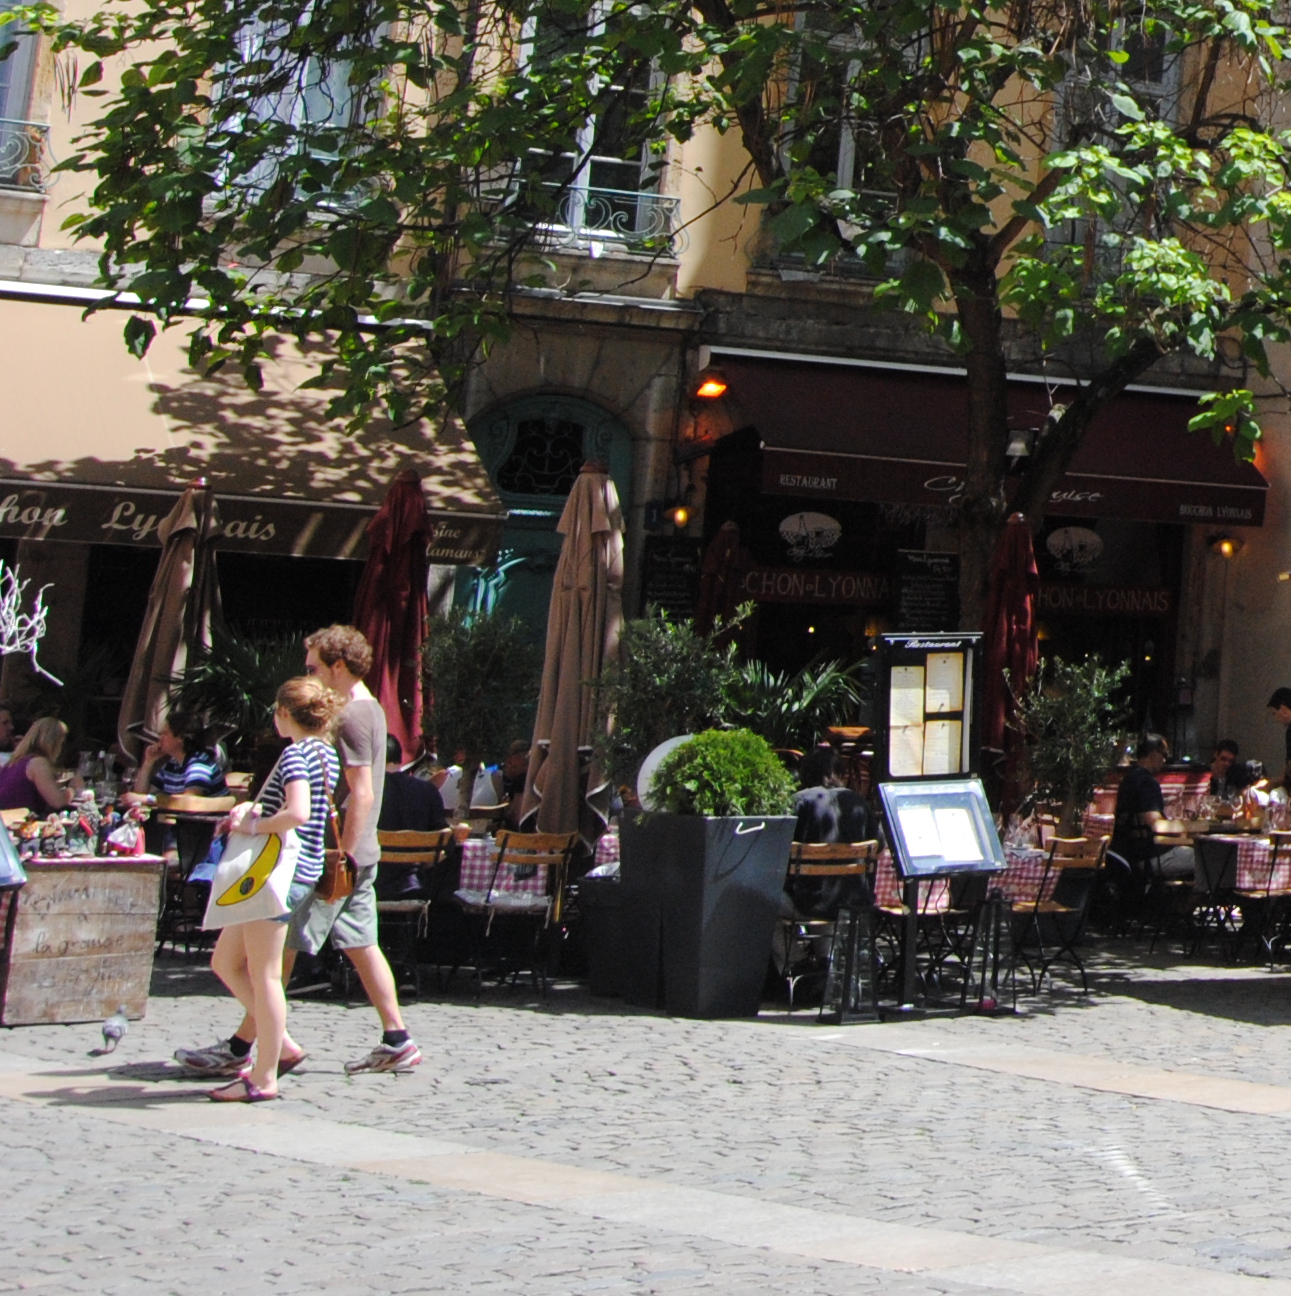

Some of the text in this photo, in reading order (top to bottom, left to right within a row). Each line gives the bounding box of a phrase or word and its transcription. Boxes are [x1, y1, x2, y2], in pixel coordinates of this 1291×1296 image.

[779, 473, 838, 490] RESTAURANT
[101, 501, 276, 542] Lyais
[1179, 504, 1253, 519] BOUCHON LYONNAIS
[740, 571, 807, 597] CHON
[1082, 588, 1170, 612] LYONNAIS
